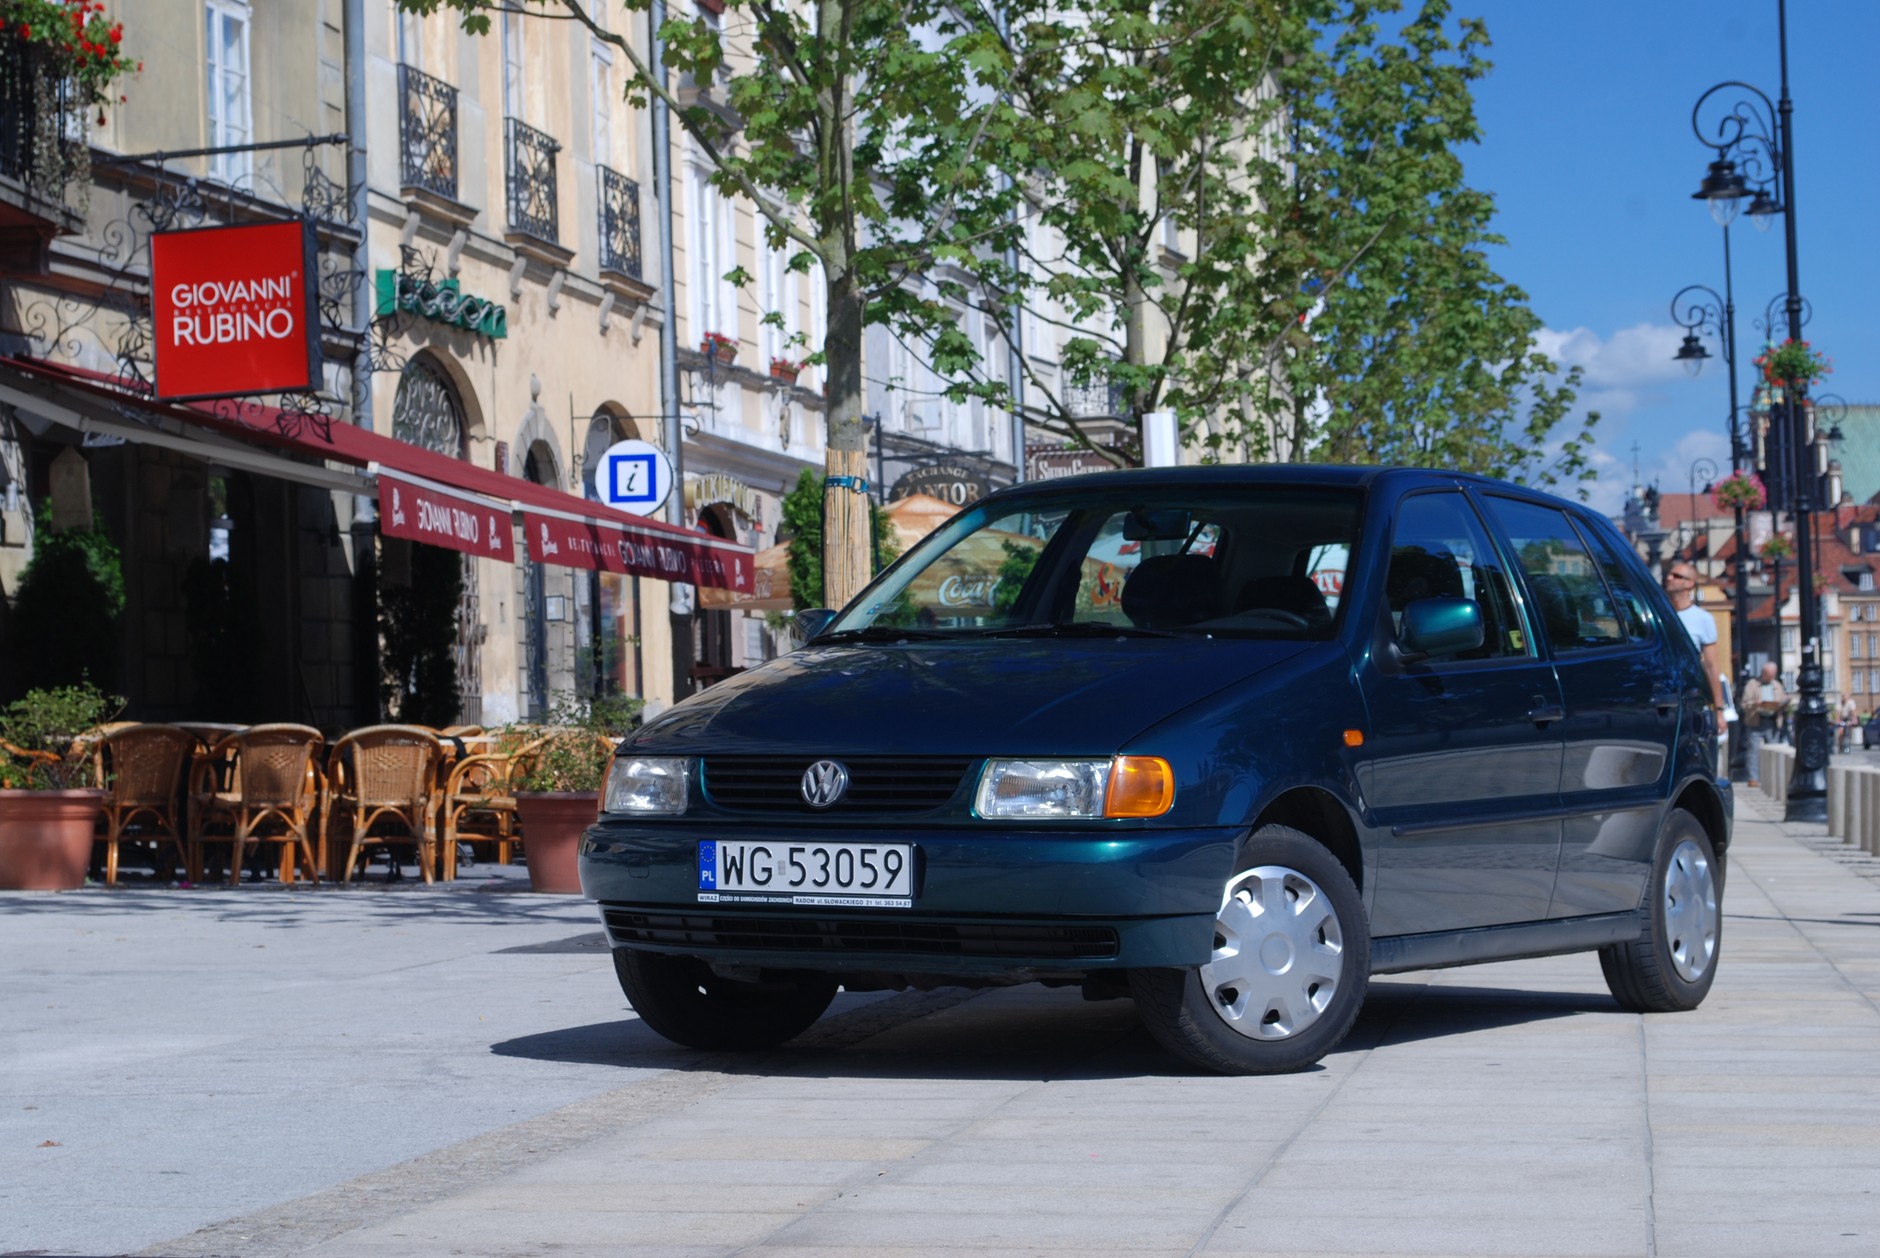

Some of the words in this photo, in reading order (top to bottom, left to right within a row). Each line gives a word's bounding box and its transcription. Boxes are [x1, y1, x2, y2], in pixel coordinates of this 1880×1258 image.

[171, 275, 291, 308] GIOVANNI
[173, 308, 294, 347] RUBINO
[626, 464, 639, 492] i
[907, 466, 969, 483] EXCHANGE
[897, 482, 980, 506] KANTOR
[416, 498, 453, 536] GIOVANNI
[453, 508, 479, 544] RUBINO
[617, 540, 656, 568] GIOVANNI
[657, 546, 687, 574] RUBINO
[701, 870, 714, 882] PL
[722, 845, 773, 886] WG
[788, 847, 903, 889] 53059
